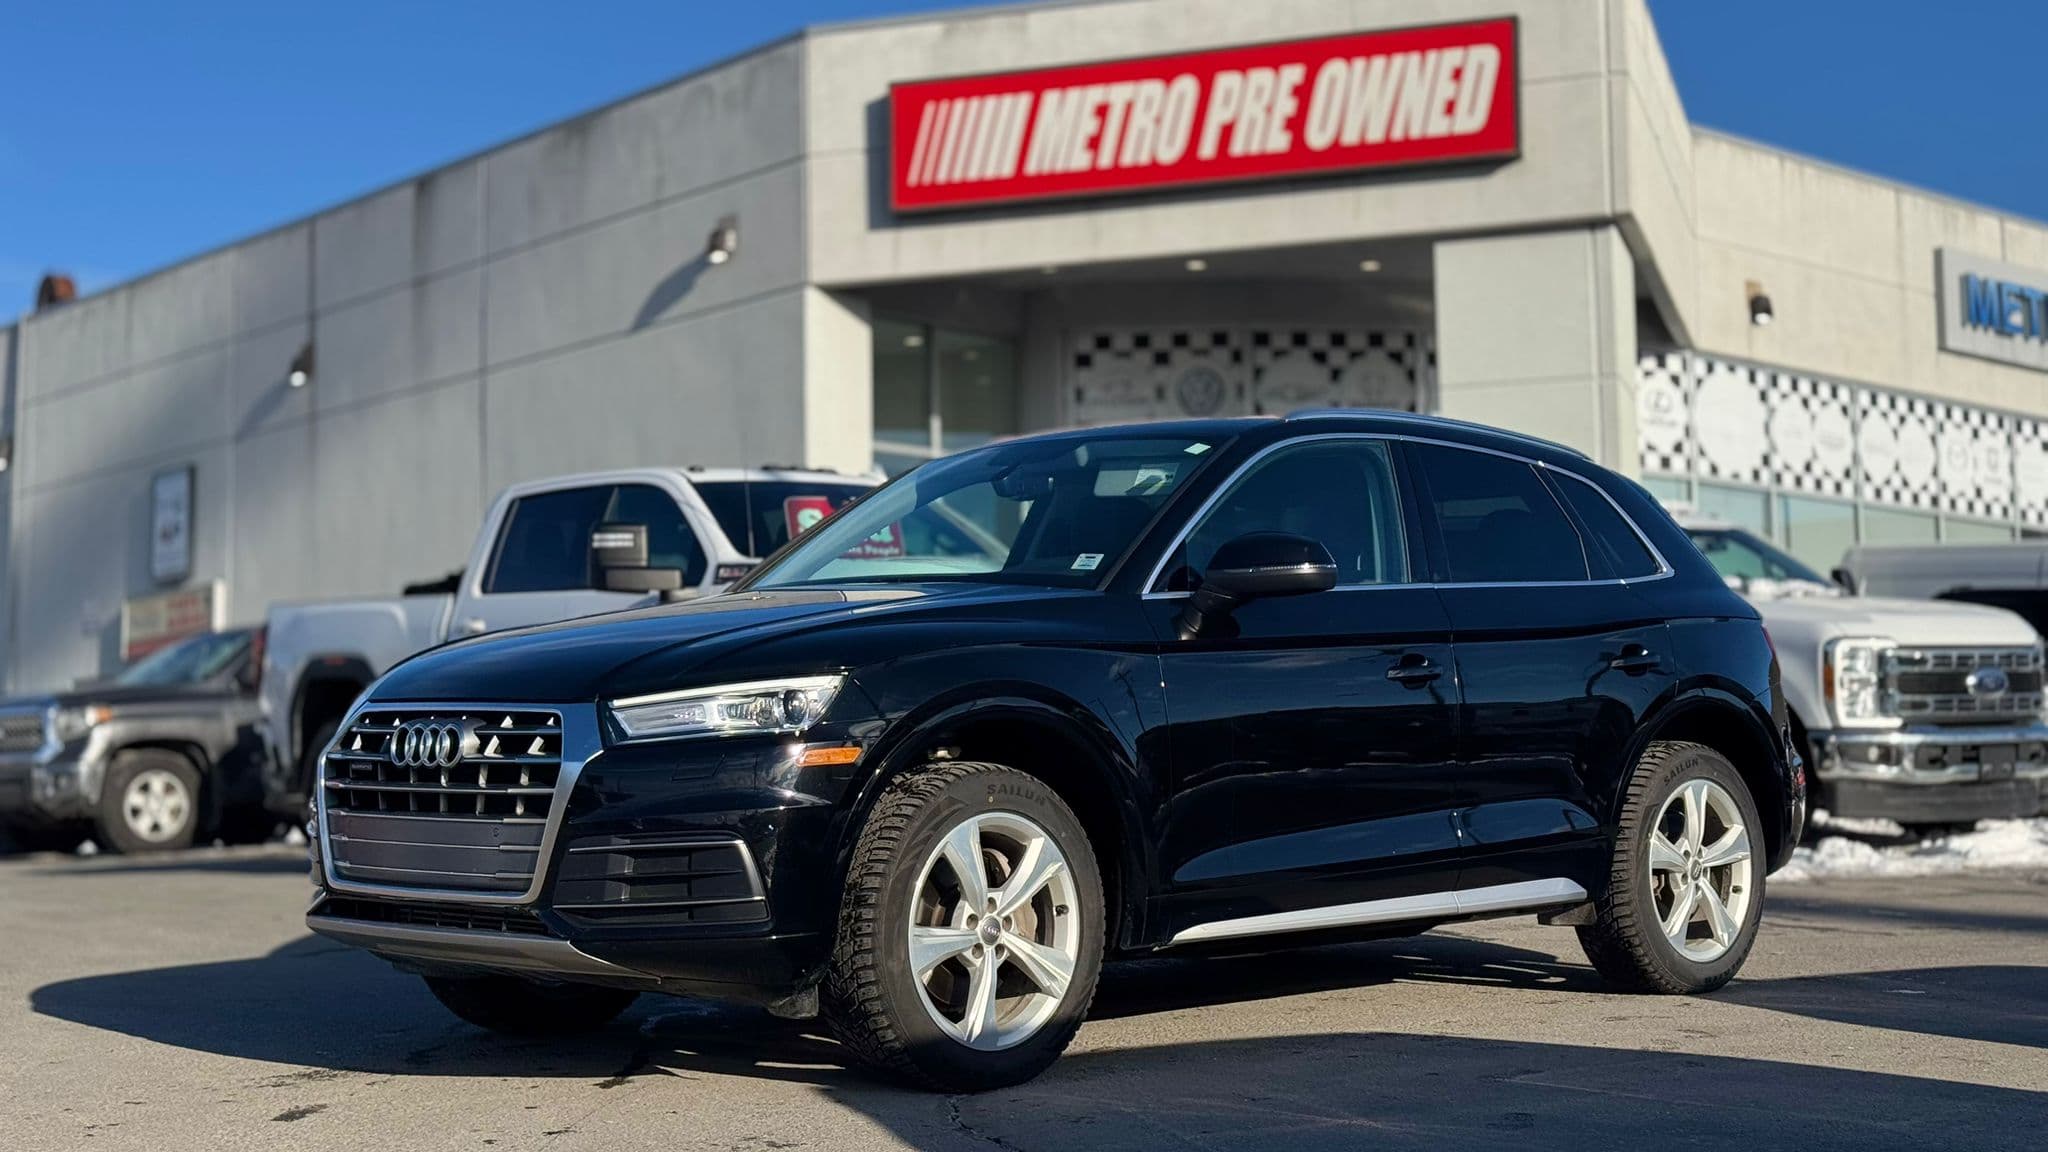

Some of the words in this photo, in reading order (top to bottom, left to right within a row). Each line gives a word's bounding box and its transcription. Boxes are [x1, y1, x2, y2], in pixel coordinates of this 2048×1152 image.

[1023, 73, 1201, 177] METRO
[1196, 63, 1307, 161] PRE
[1303, 43, 1502, 152] OWNED
[1963, 272, 2048, 340] MET
[1663, 758, 1699, 787] SAILUN
